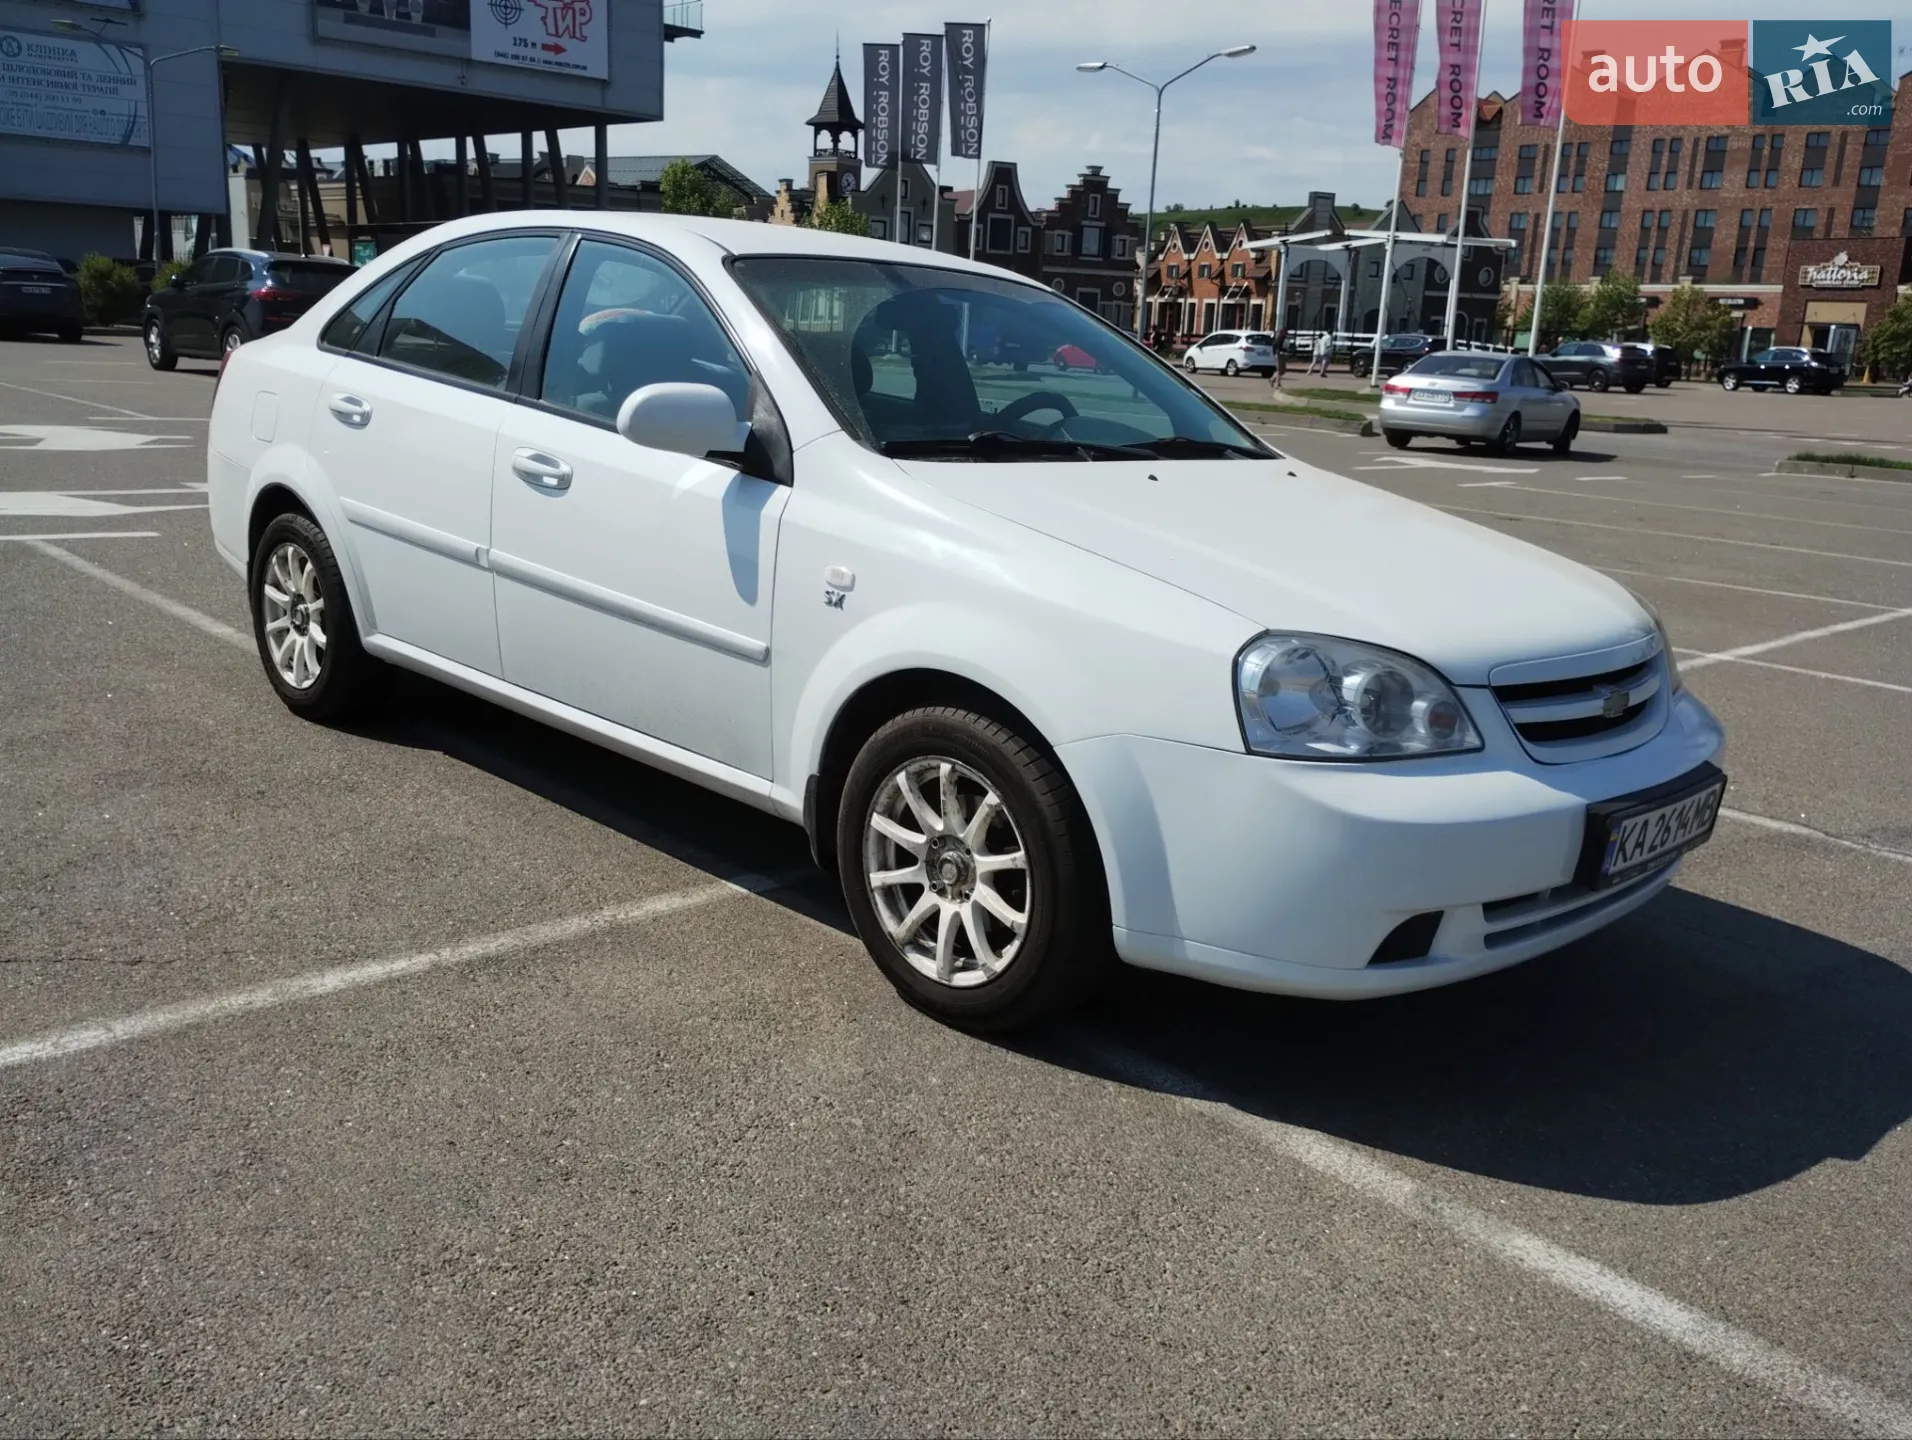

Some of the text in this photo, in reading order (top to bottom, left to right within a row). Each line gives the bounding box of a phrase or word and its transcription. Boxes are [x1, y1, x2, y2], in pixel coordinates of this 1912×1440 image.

[26, 43, 77, 58] КЛІНІКА
[512, 36, 528, 48] 175
[80, 71, 93, 81] ТА
[877, 49, 889, 166] ROY ROBSON
[915, 39, 932, 160] ROY ROBSON
[962, 29, 979, 155] ROY ROBSON
[1381, 77, 1398, 140] ROOM
[1449, 63, 1463, 129] ROOM
[1533, 47, 1552, 119] ROOM
